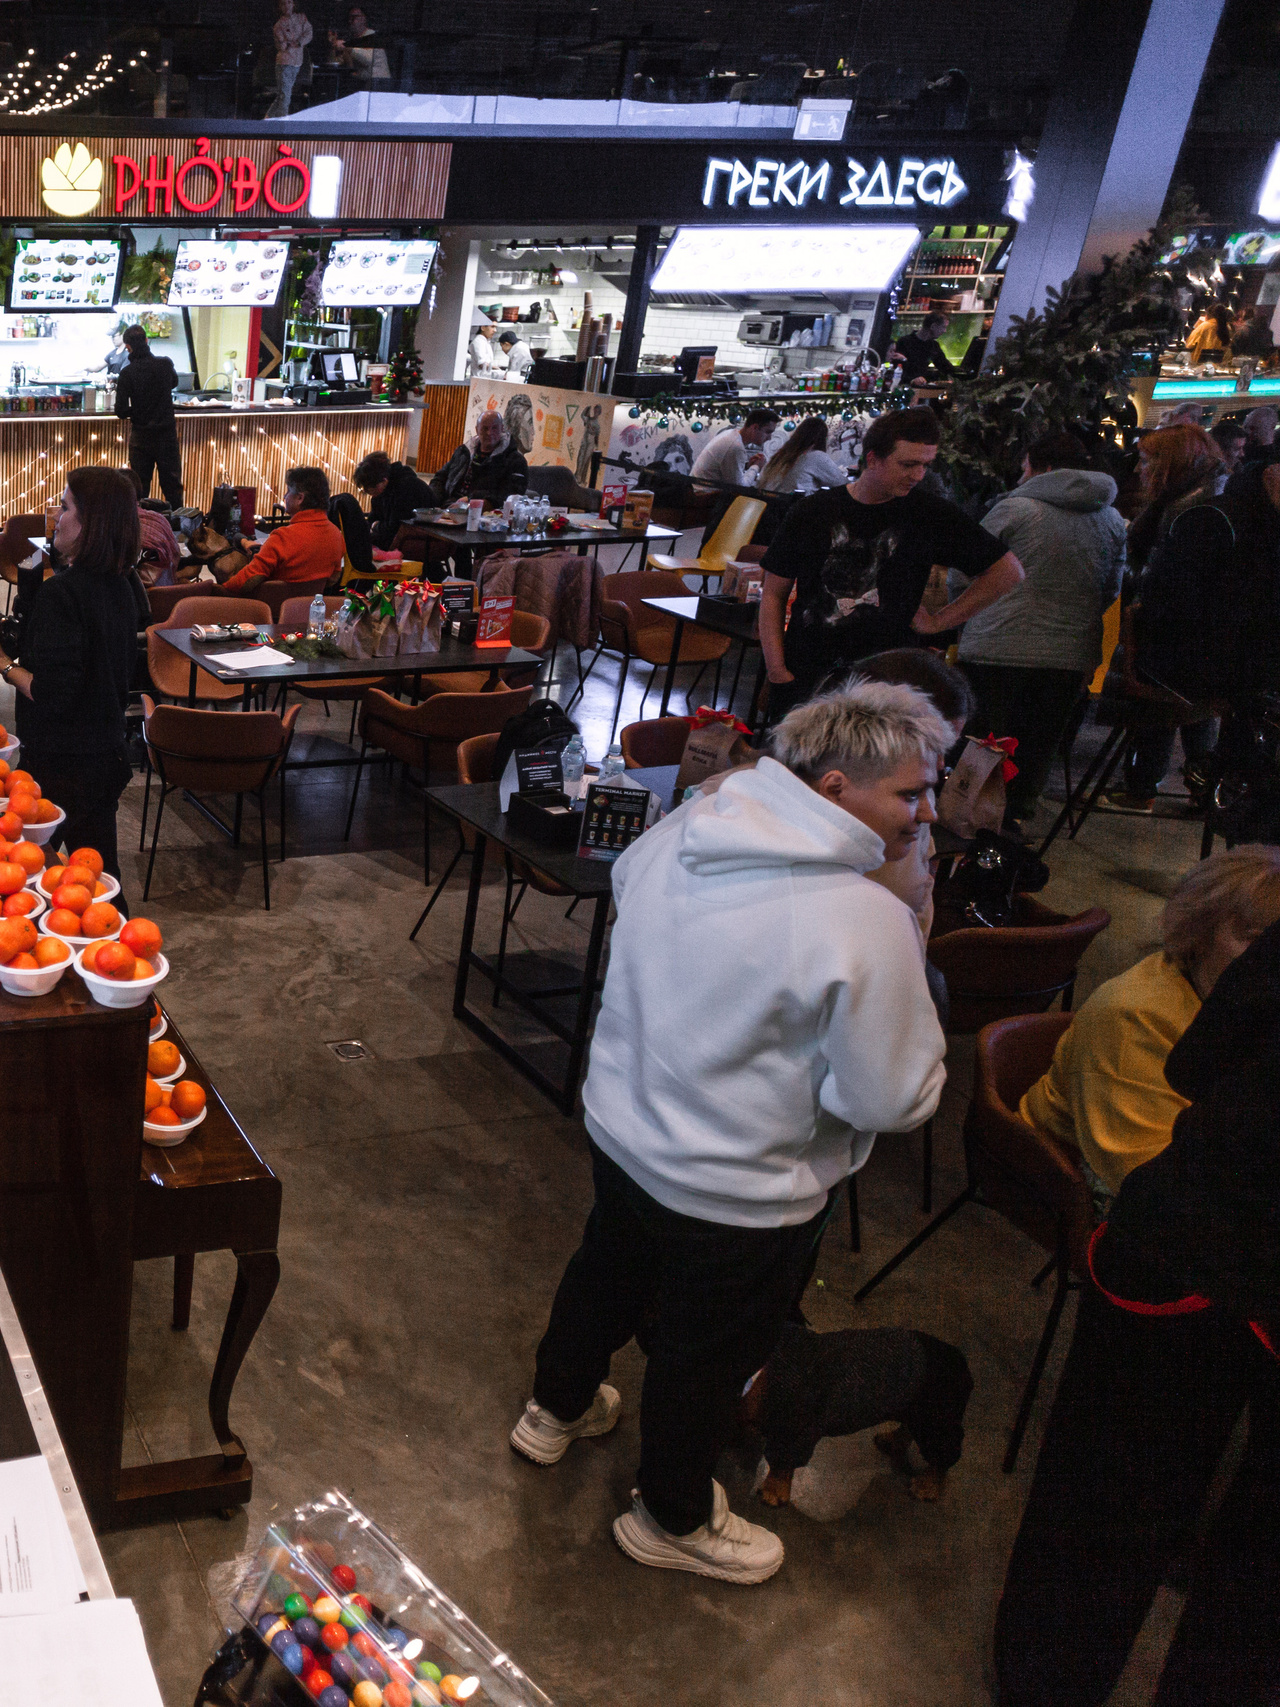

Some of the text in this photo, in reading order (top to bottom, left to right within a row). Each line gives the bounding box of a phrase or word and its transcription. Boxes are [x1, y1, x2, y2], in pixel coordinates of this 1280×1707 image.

[702, 159, 966, 206] ГРЕКИ ЗДЕСЬ
[595, 787, 647, 797] TERMINAL MARKET
